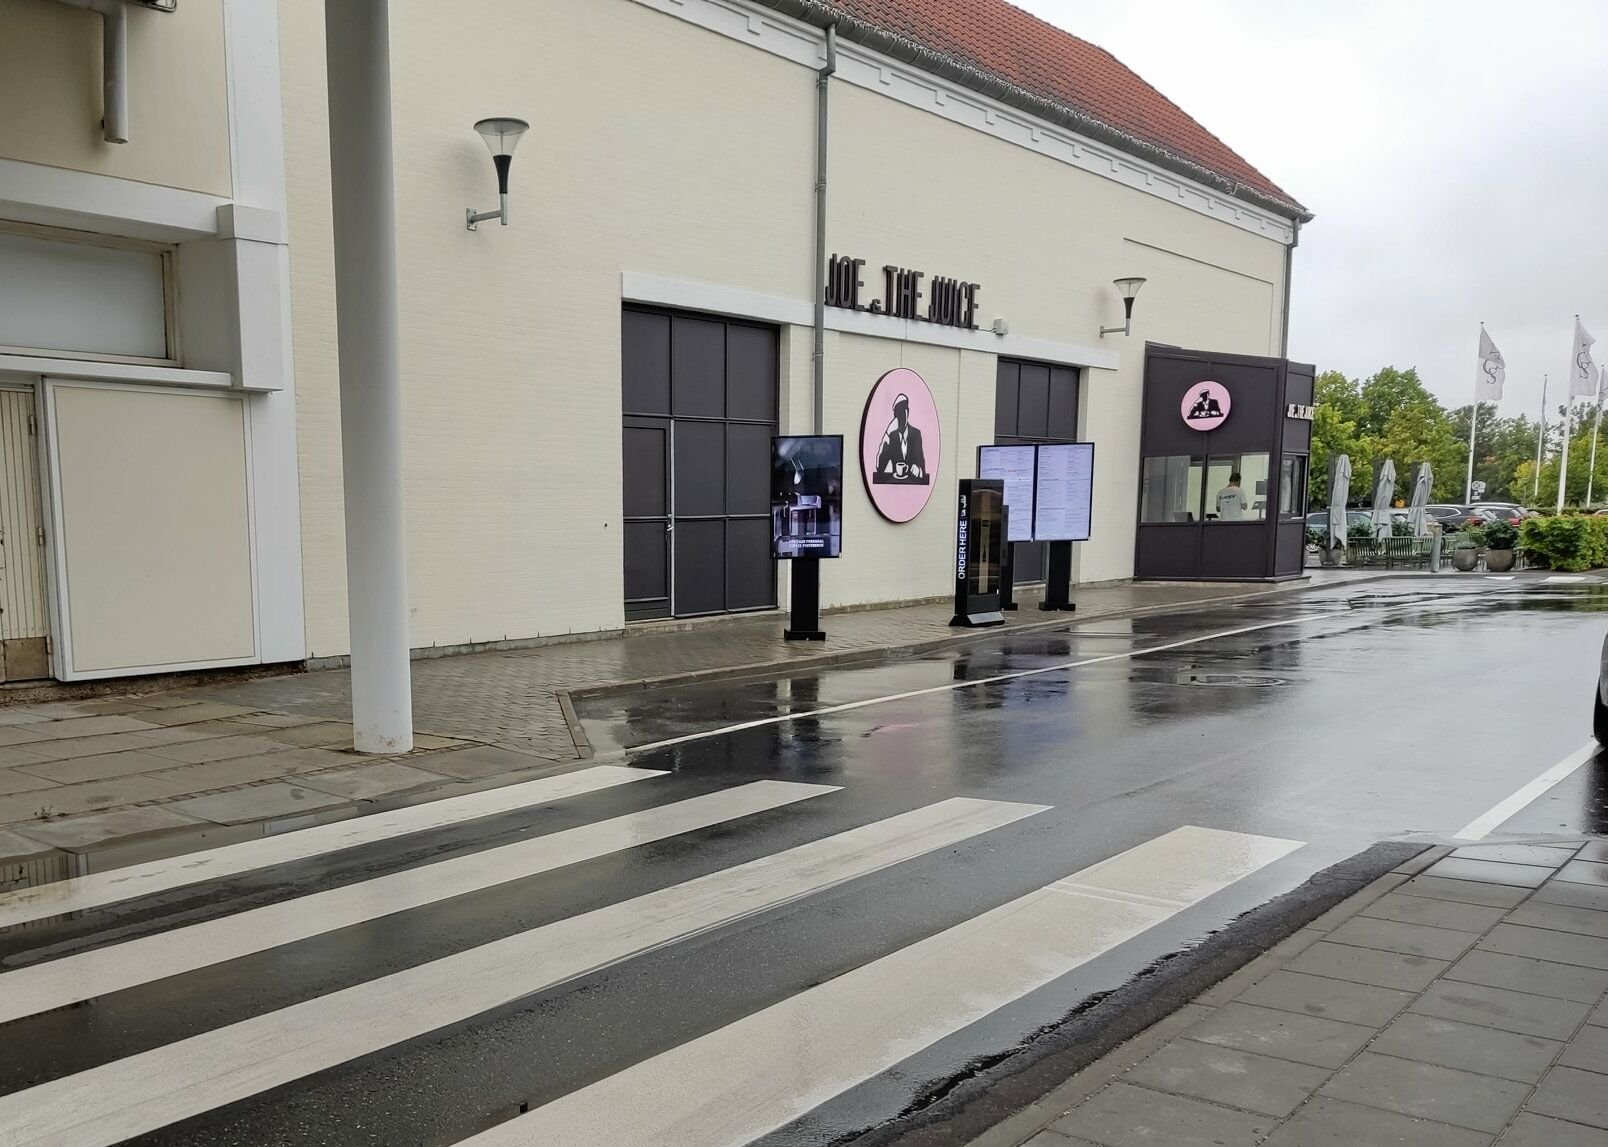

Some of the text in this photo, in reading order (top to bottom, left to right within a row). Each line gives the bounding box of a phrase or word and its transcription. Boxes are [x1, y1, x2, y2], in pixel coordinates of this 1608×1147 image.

[824, 253, 981, 330] JOE & THE JUICE
[958, 520, 967, 579] ORDER HERE
